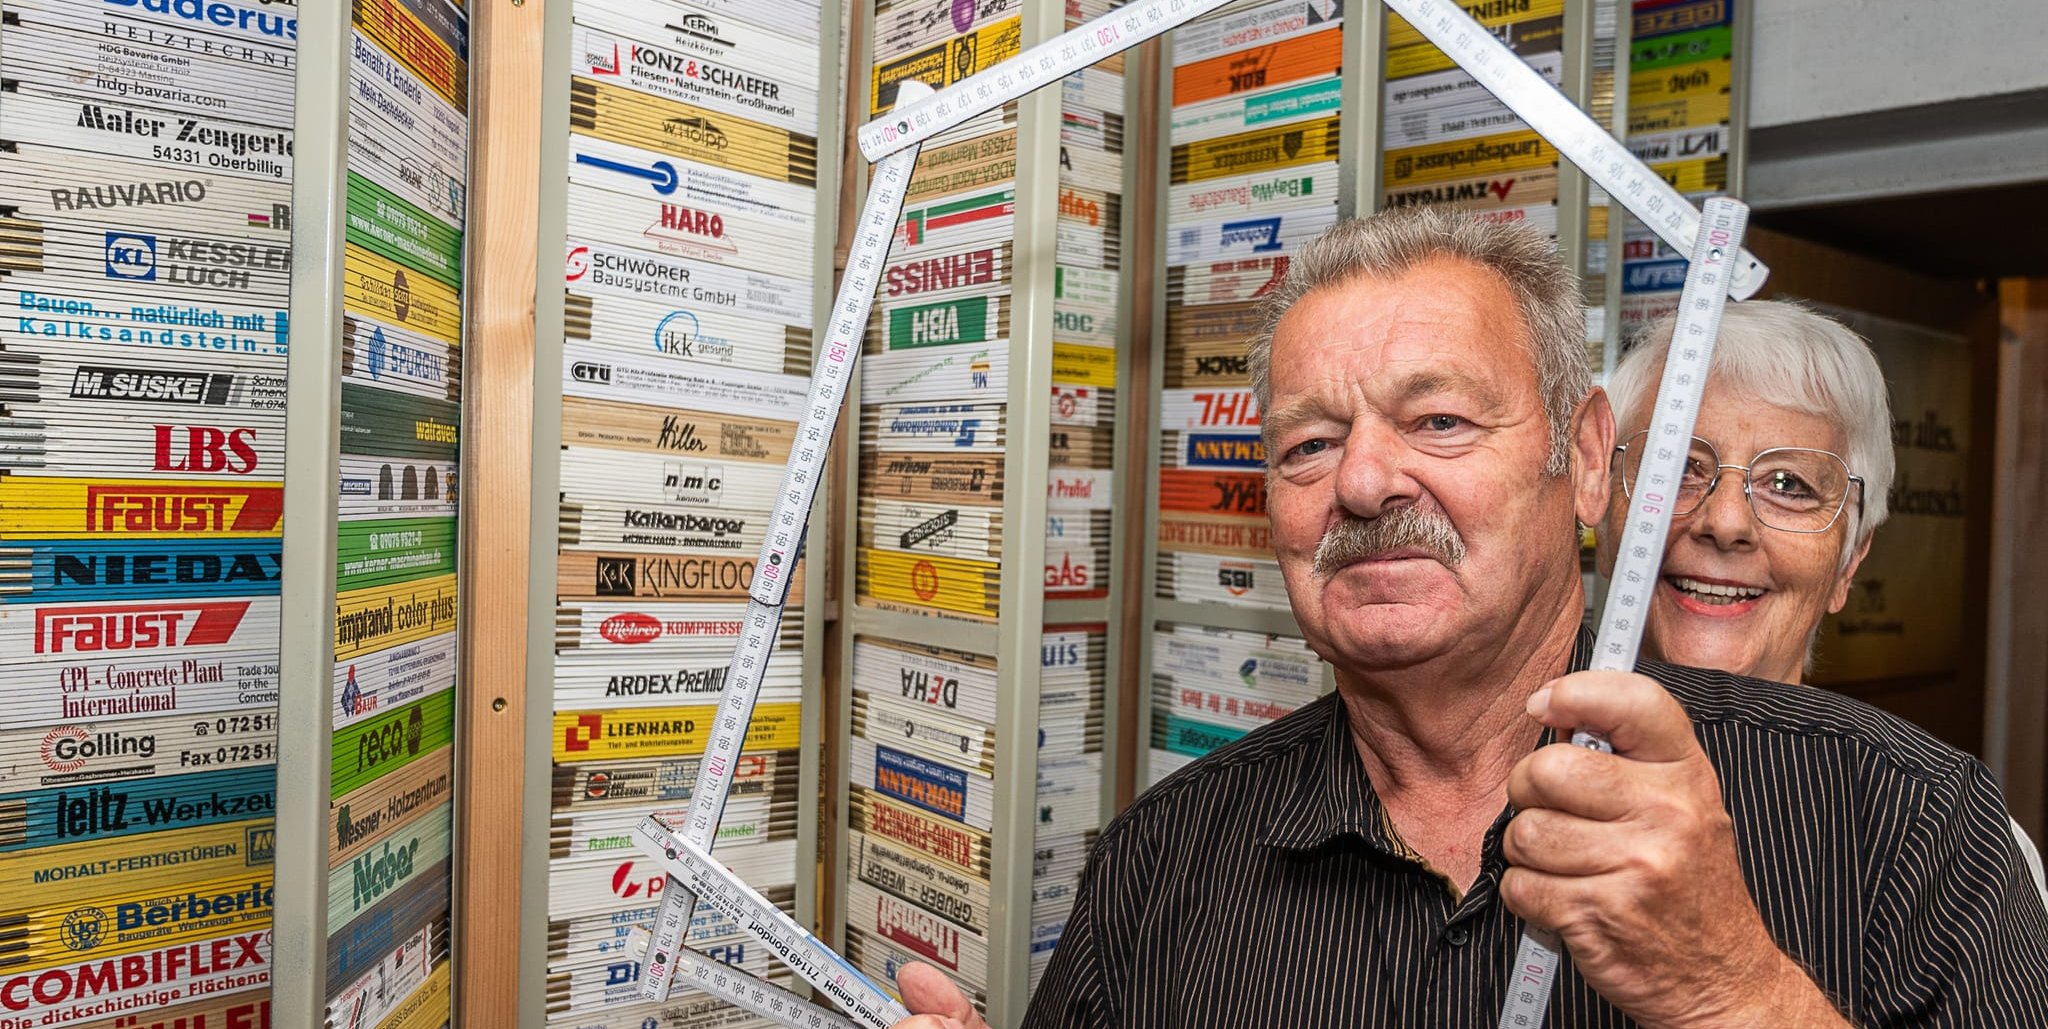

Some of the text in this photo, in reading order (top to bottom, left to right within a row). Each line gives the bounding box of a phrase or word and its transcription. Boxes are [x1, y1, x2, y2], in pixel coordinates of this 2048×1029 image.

[103, 0, 296, 40] uderus
[98, 43, 190, 67] HDG Bavaria GmbH
[676, 37, 724, 56] Heizkörper
[355, 37, 384, 74] Benath
[393, 68, 422, 105] Enderle
[632, 44, 683, 74] KONZ
[686, 61, 698, 78] &
[702, 65, 779, 100] SCHAEFER
[96, 75, 227, 109] hdg-bavaria.com
[77, 104, 166, 138] Maler
[152, 145, 283, 177] 54331 Oberbillig
[1252, 178, 1298, 200] BayWa
[661, 202, 724, 238] HARO
[113, 247, 150, 266] KL
[593, 253, 690, 282] SCHWÖRER
[168, 264, 250, 289] LUCH
[593, 270, 689, 298] Bausysteme
[693, 287, 736, 307] GmbH
[887, 250, 994, 297] EHNISS
[19, 290, 265, 331] Bauen... natürlich mit
[19, 317, 268, 353] Kalksandstein.
[664, 332, 694, 357] ikk
[699, 342, 734, 357] gesund
[391, 345, 441, 381] SPURGIN
[574, 363, 611, 382] GTÜ
[782, 211, 885, 526] 144 148 150 152 155 158
[75, 371, 203, 400] M.SUSKE
[416, 418, 457, 444] walraven
[657, 416, 707, 450] Hiller
[152, 425, 258, 474] LBS
[624, 510, 745, 536] Kallenberger
[1219, 569, 1254, 588] IBS
[398, 590, 453, 630] color plus
[60, 666, 89, 693] CPI
[106, 664, 177, 690] Concrete
[182, 659, 224, 684] Plant
[237, 665, 262, 677] Trade
[238, 678, 268, 690] for the
[606, 672, 676, 696] ARDEX
[62, 686, 176, 718] International
[238, 691, 278, 704] Concrete
[901, 668, 958, 708] DEHA
[355, 695, 377, 715] BAUR
[608, 720, 694, 737] LIENHARD
[700, 635, 760, 811] 164 167 170 172
[55, 732, 155, 760] Golling
[181, 751, 211, 766] Fax
[640, 738, 693, 748] Rohrleitungsbau
[57, 787, 128, 838] leitz
[388, 774, 446, 823] Holzzentrum
[34, 843, 237, 883] MORALT-FERTIGTÜREN
[867, 863, 906, 889] WEBER
[922, 884, 973, 922] GRUBER
[1, 933, 265, 1011] COMBIFLEX
[749, 923, 856, 1009] GmbH 71149 Bondorf
[1523, 963, 1544, 986] 70
[42, 989, 181, 1026] dickschichtige
[713, 973, 782, 1013] 183 186
